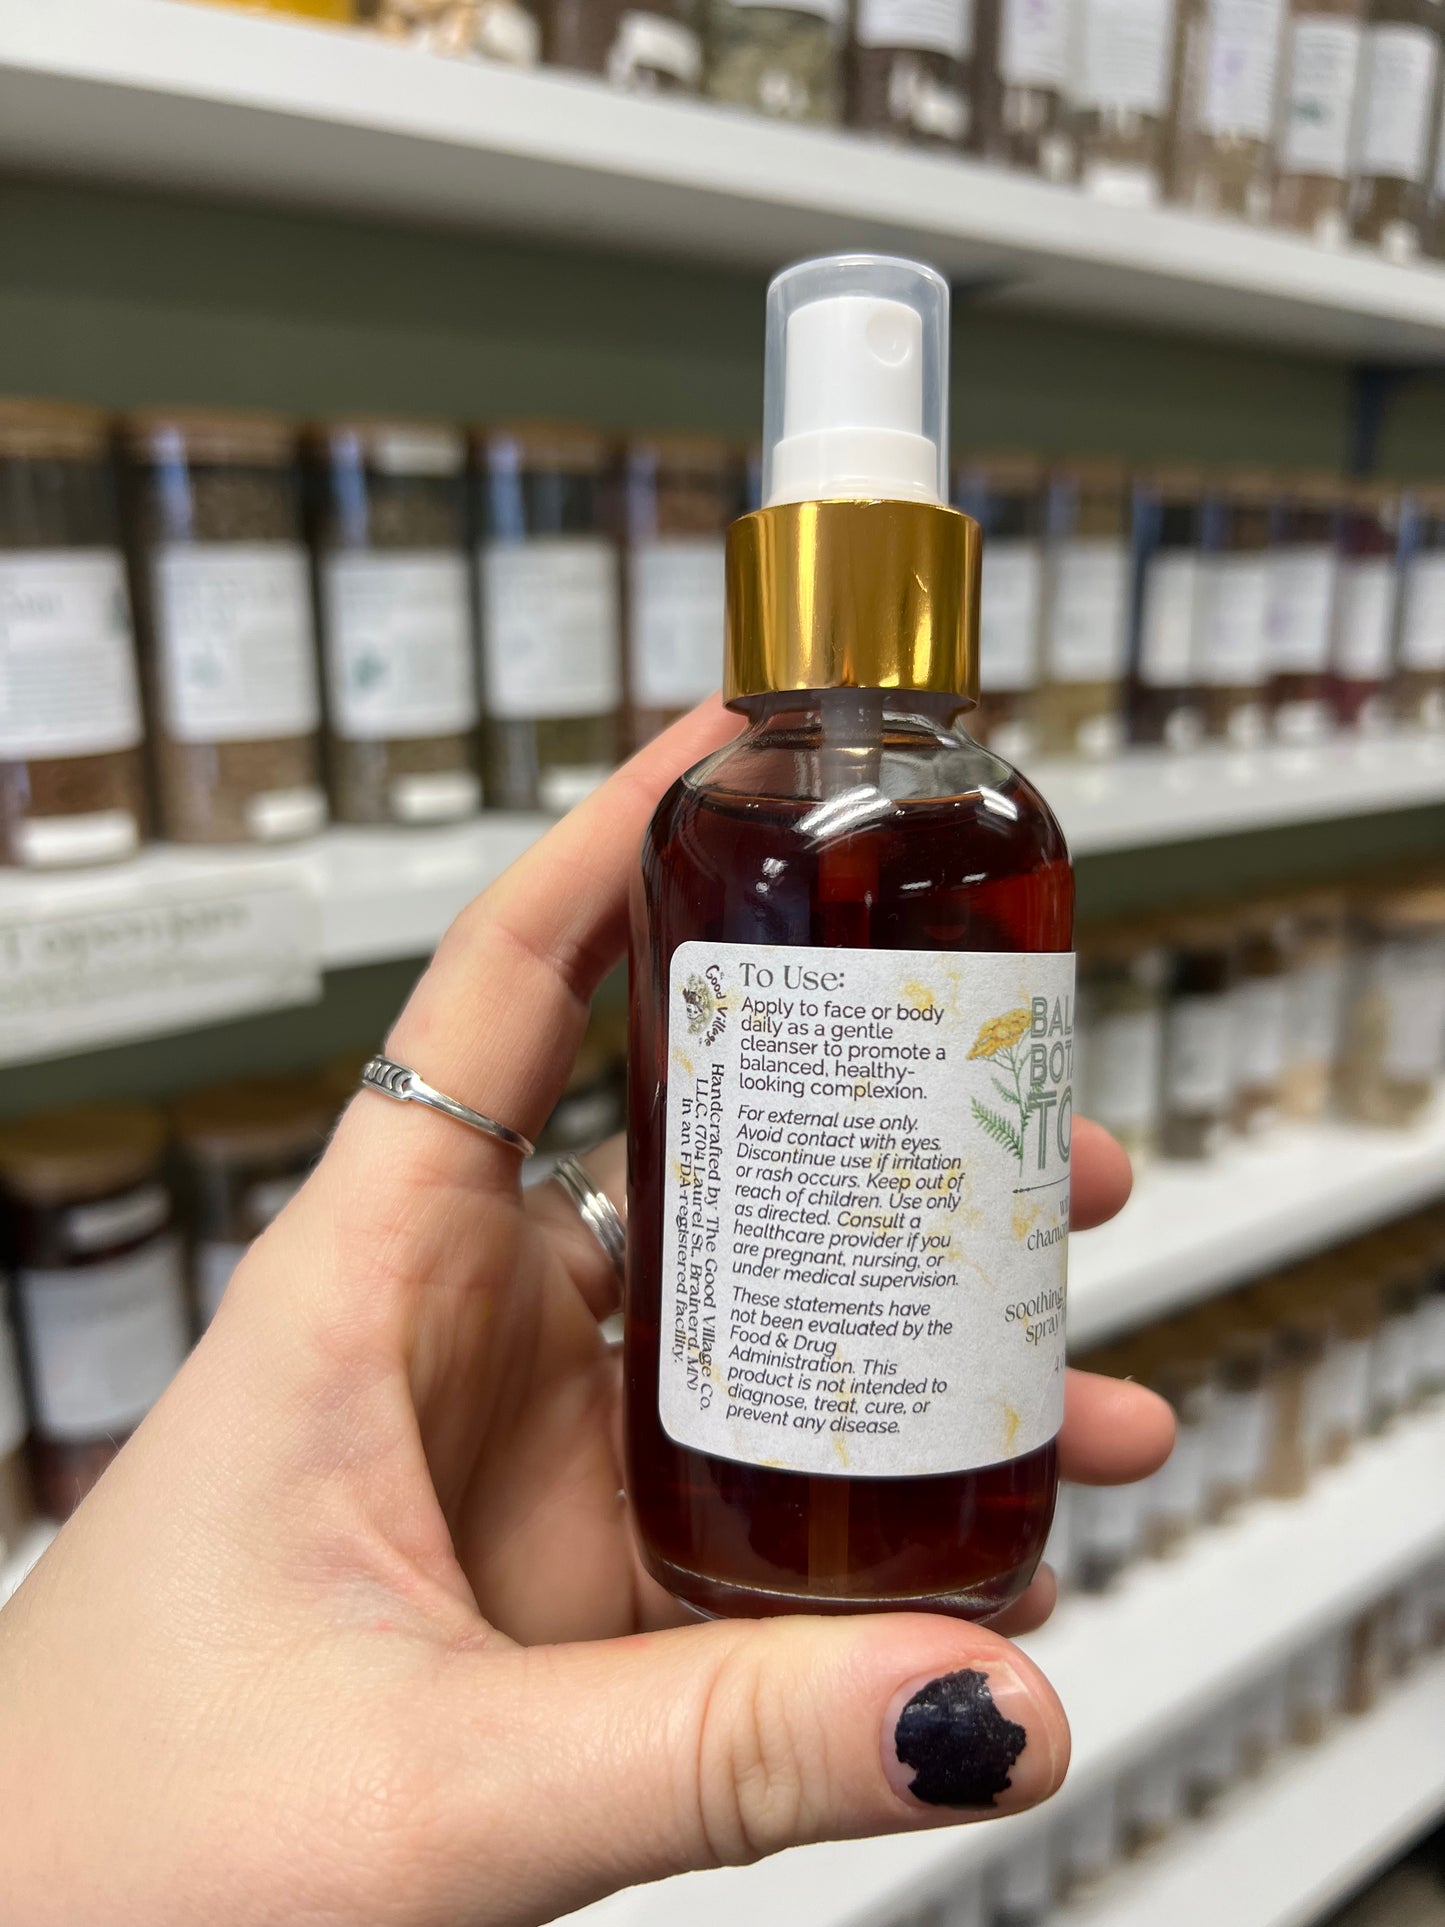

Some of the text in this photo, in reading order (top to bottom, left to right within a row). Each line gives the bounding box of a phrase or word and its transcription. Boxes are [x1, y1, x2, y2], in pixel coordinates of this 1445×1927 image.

[739, 962, 845, 991] To Use:
[741, 996, 944, 1025] Apply to face or body
[1031, 994, 1074, 1038] BAL
[741, 1017, 893, 1041] daily as a gentle
[741, 1035, 946, 1061] cleanser to promote a
[740, 1054, 915, 1084] balanced, healthy-
[740, 1073, 927, 1101] looking complexion.
[681, 1121, 692, 1145] an
[737, 1104, 919, 1135] For external use only.
[737, 1124, 942, 1156] Avoid contact with eyes.
[737, 1143, 962, 1173] Discontinue use if irritation
[736, 1165, 966, 1195] or rash occurs. Keep out of
[692, 1165, 705, 1229] Laurel
[735, 1184, 962, 1213] reach of children. Use only
[735, 1203, 921, 1229] as directed. Consult a
[699, 1063, 725, 1411] Handcrafted by The Good Village Co.
[733, 1219, 951, 1254] healthcare provider if you
[733, 1242, 945, 1272] are pregnant, nursing, or
[732, 1261, 959, 1291] under medical supervision.
[733, 1286, 931, 1317] These statements have
[730, 1308, 953, 1340] not been evaluated by the
[730, 1325, 837, 1358] Food & Drug
[728, 1344, 898, 1375] Administration. This
[727, 1366, 948, 1395] product is not intended to
[728, 1384, 931, 1415] diagnose, treat, cure, or
[726, 1404, 900, 1434] prevent any disease.
